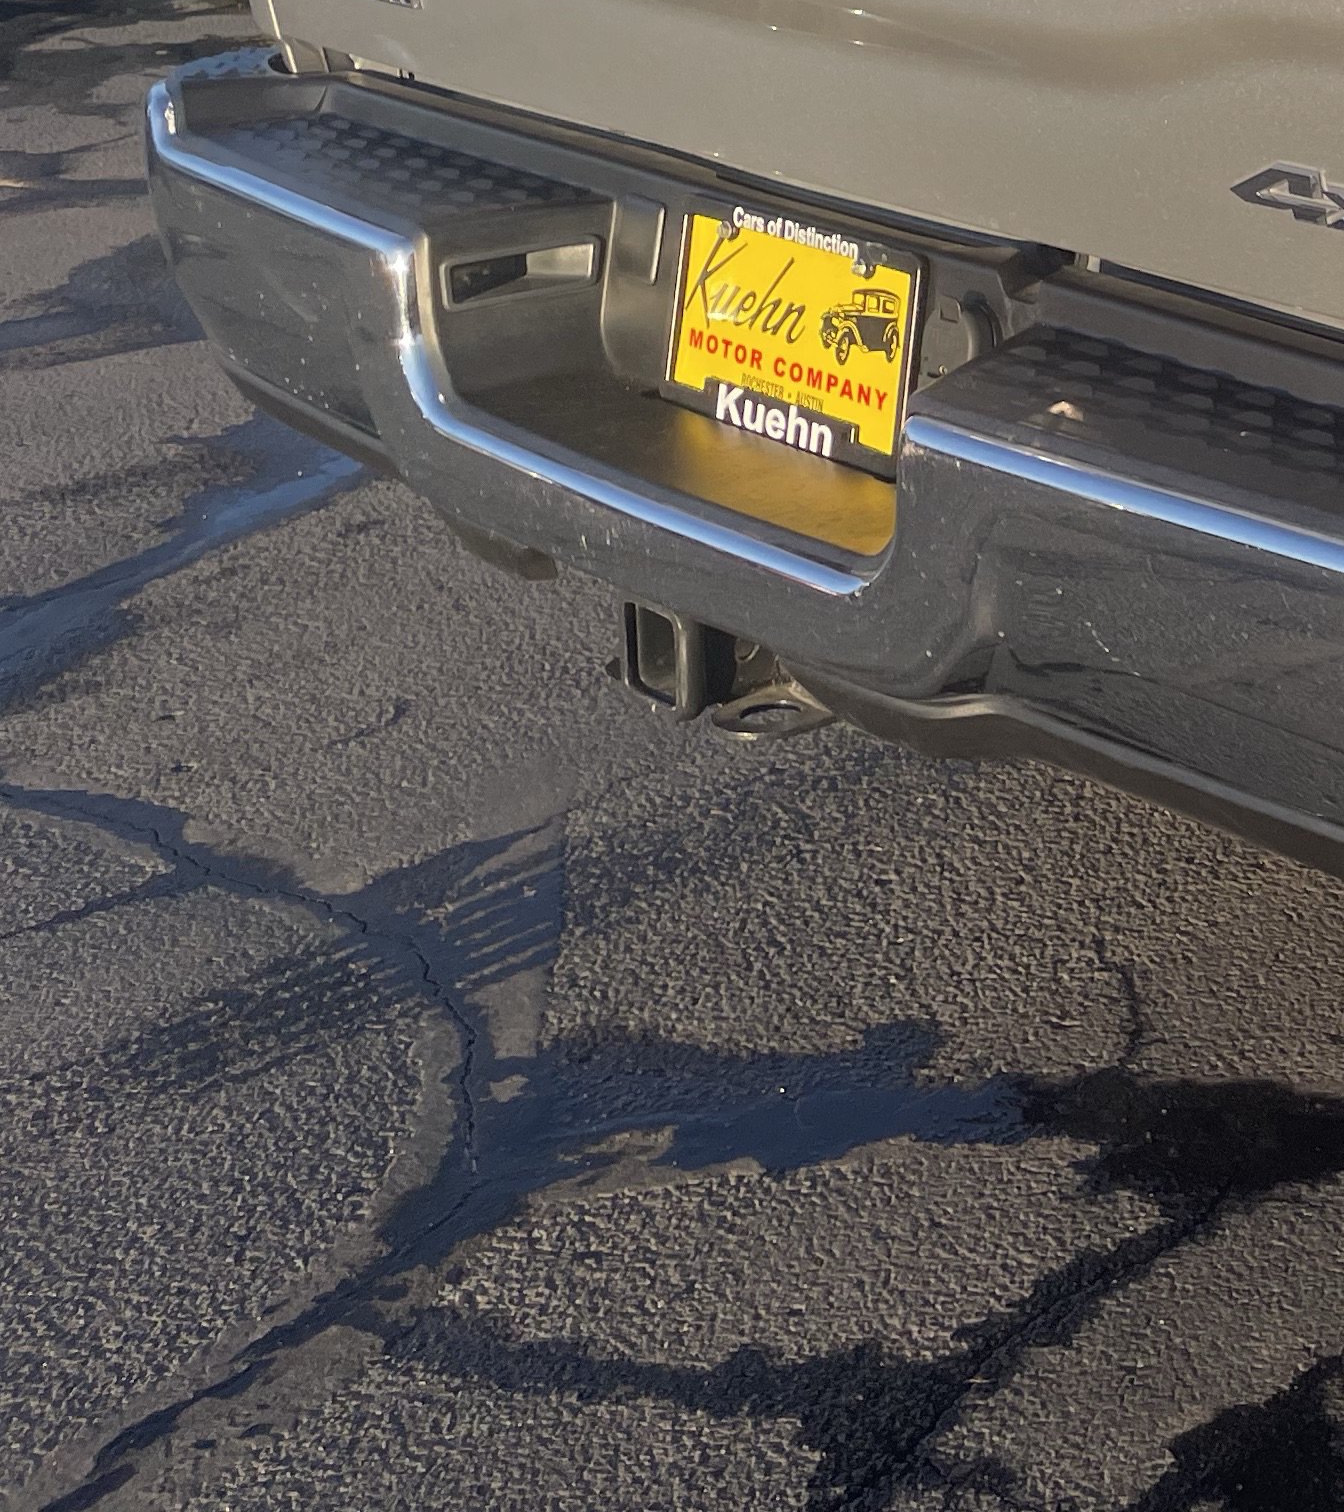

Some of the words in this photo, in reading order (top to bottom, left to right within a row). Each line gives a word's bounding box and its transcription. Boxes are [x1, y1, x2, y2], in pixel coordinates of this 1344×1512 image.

[732, 206, 764, 234] Cars
[767, 217, 783, 236] of
[784, 220, 859, 260] Distinction
[685, 236, 807, 345] Kuehn
[689, 328, 763, 371] MOTOR
[773, 357, 888, 412] COMPANY
[741, 372, 784, 400] ROCHESTER
[795, 391, 825, 413] AUSTIN
[715, 383, 833, 457] Kuehn
